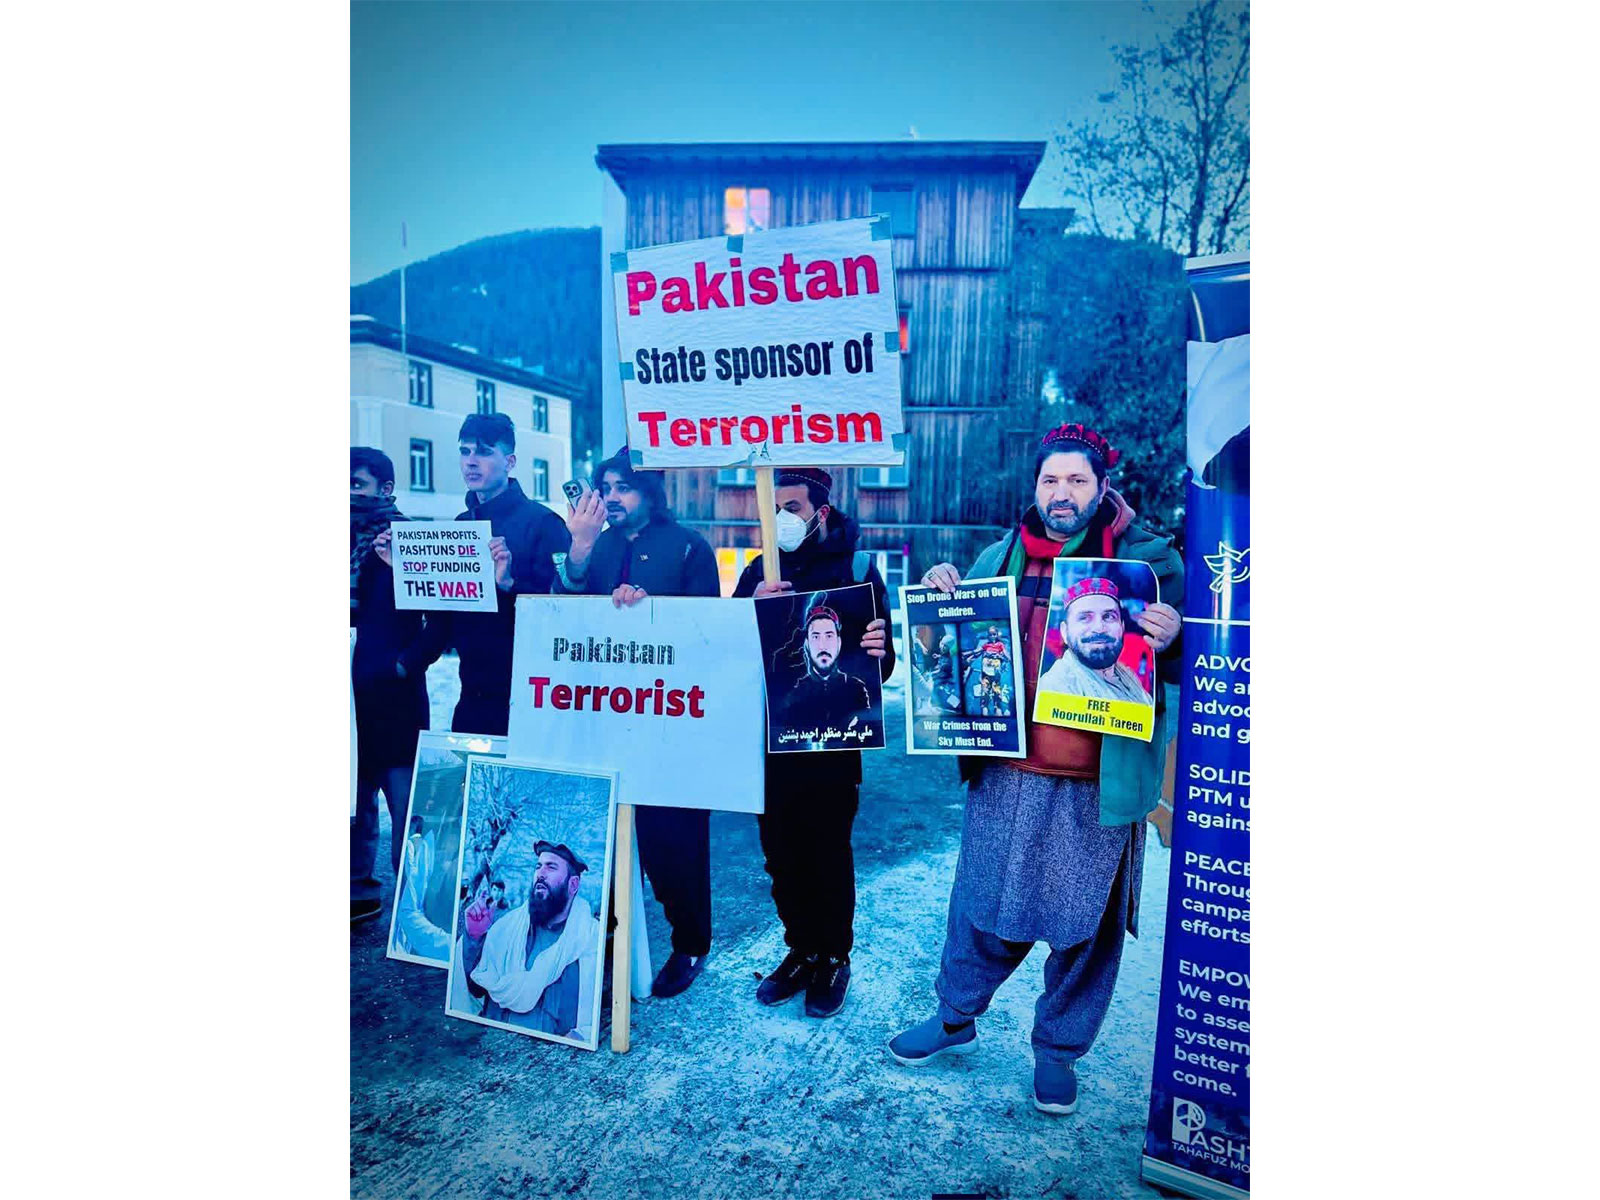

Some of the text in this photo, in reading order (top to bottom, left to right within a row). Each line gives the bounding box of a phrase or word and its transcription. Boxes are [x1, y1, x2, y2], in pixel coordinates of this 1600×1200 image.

[626, 253, 880, 316] Pakistan
[636, 332, 874, 385] State sponsor of
[638, 404, 883, 447] Terrorism
[397, 531, 480, 540] PAKISTAN PROFITS.
[399, 545, 480, 556] PASHTUNS DIE.
[402, 561, 481, 573] STOP FUNDING
[404, 580, 484, 599] THE WAR!
[907, 587, 1008, 604] Stop Drone Wars on Our
[938, 607, 976, 617] Children.
[553, 636, 676, 665] Pakistan
[1194, 675, 1250, 695] We a
[528, 676, 705, 718] Terrorist
[1087, 699, 1111, 712] FREE
[923, 721, 1007, 731] War Crimes from the
[1052, 708, 1143, 733] Noorullah Tareen
[1191, 722, 1230, 738] and
[938, 737, 994, 747] Sky Must End.
[1189, 763, 1250, 786] SOLID
[1188, 785, 1232, 807] PTM
[1181, 919, 1250, 945] efforts
[1178, 980, 1212, 1002] We
[1176, 1003, 1197, 1020] to
[1175, 1027, 1250, 1056] system
[1174, 1044, 1240, 1075] better
[1172, 1069, 1237, 1097] come.
[1172, 1096, 1250, 1161] PASH
[1172, 1141, 1228, 1167] TAHAFUZ
